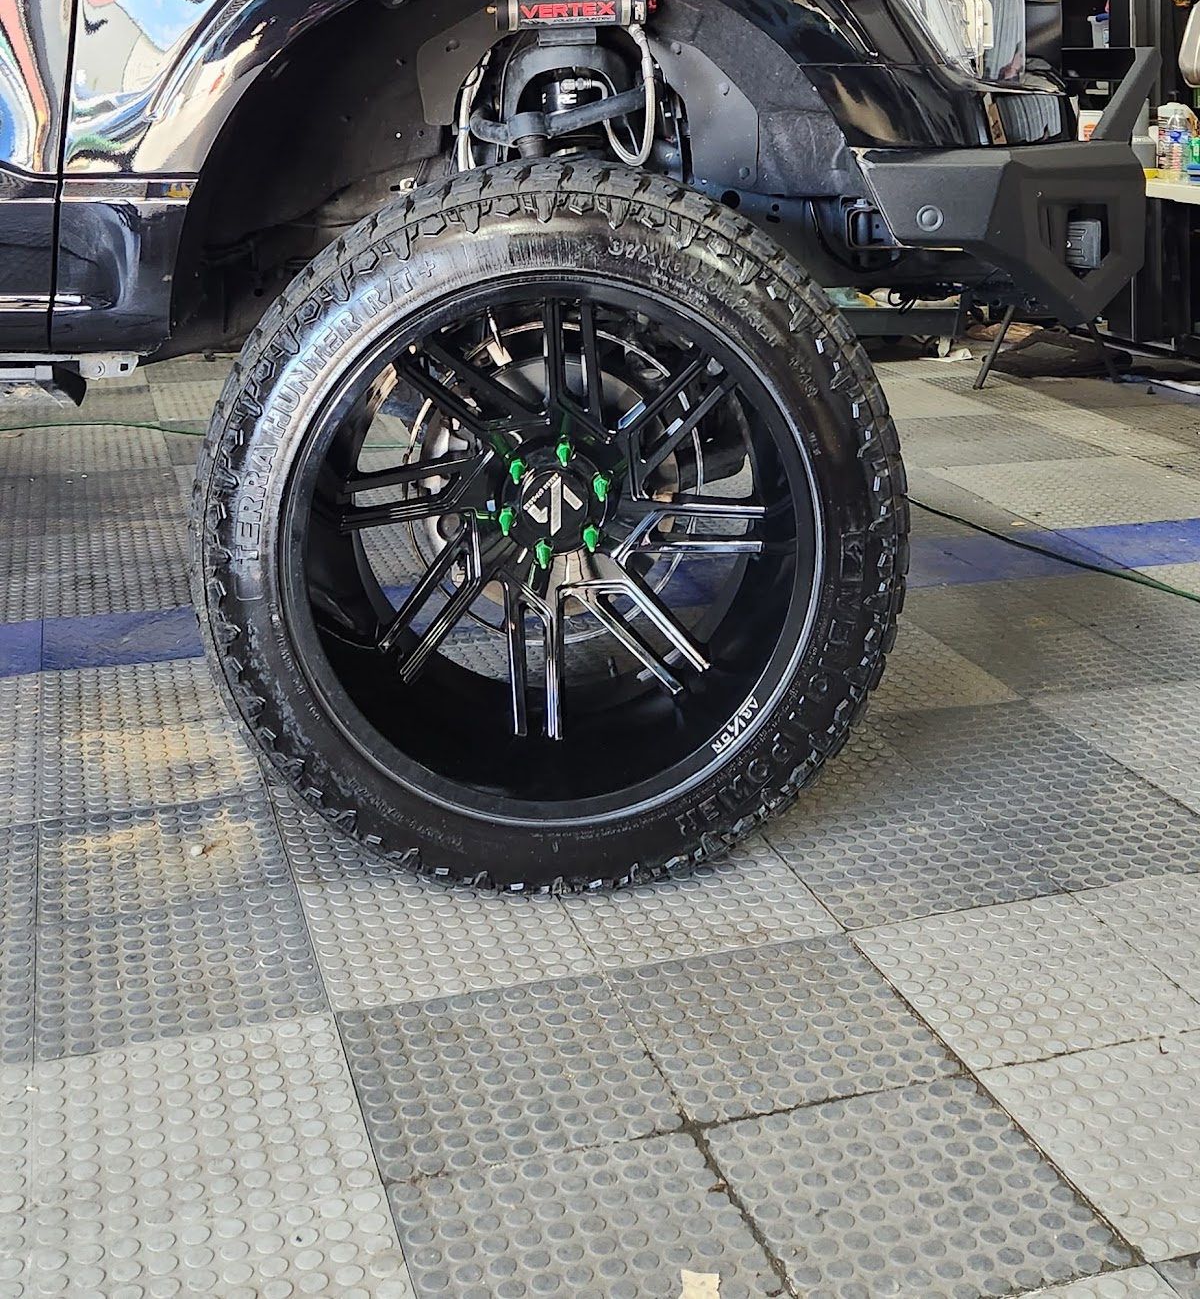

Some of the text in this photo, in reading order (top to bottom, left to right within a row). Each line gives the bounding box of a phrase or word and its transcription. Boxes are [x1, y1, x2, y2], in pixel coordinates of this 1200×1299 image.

[520, 1, 616, 19] VERTEX
[235, 443, 279, 565] TERRA
[262, 308, 362, 440] HUNTER
[711, 695, 759, 754] ARKON
